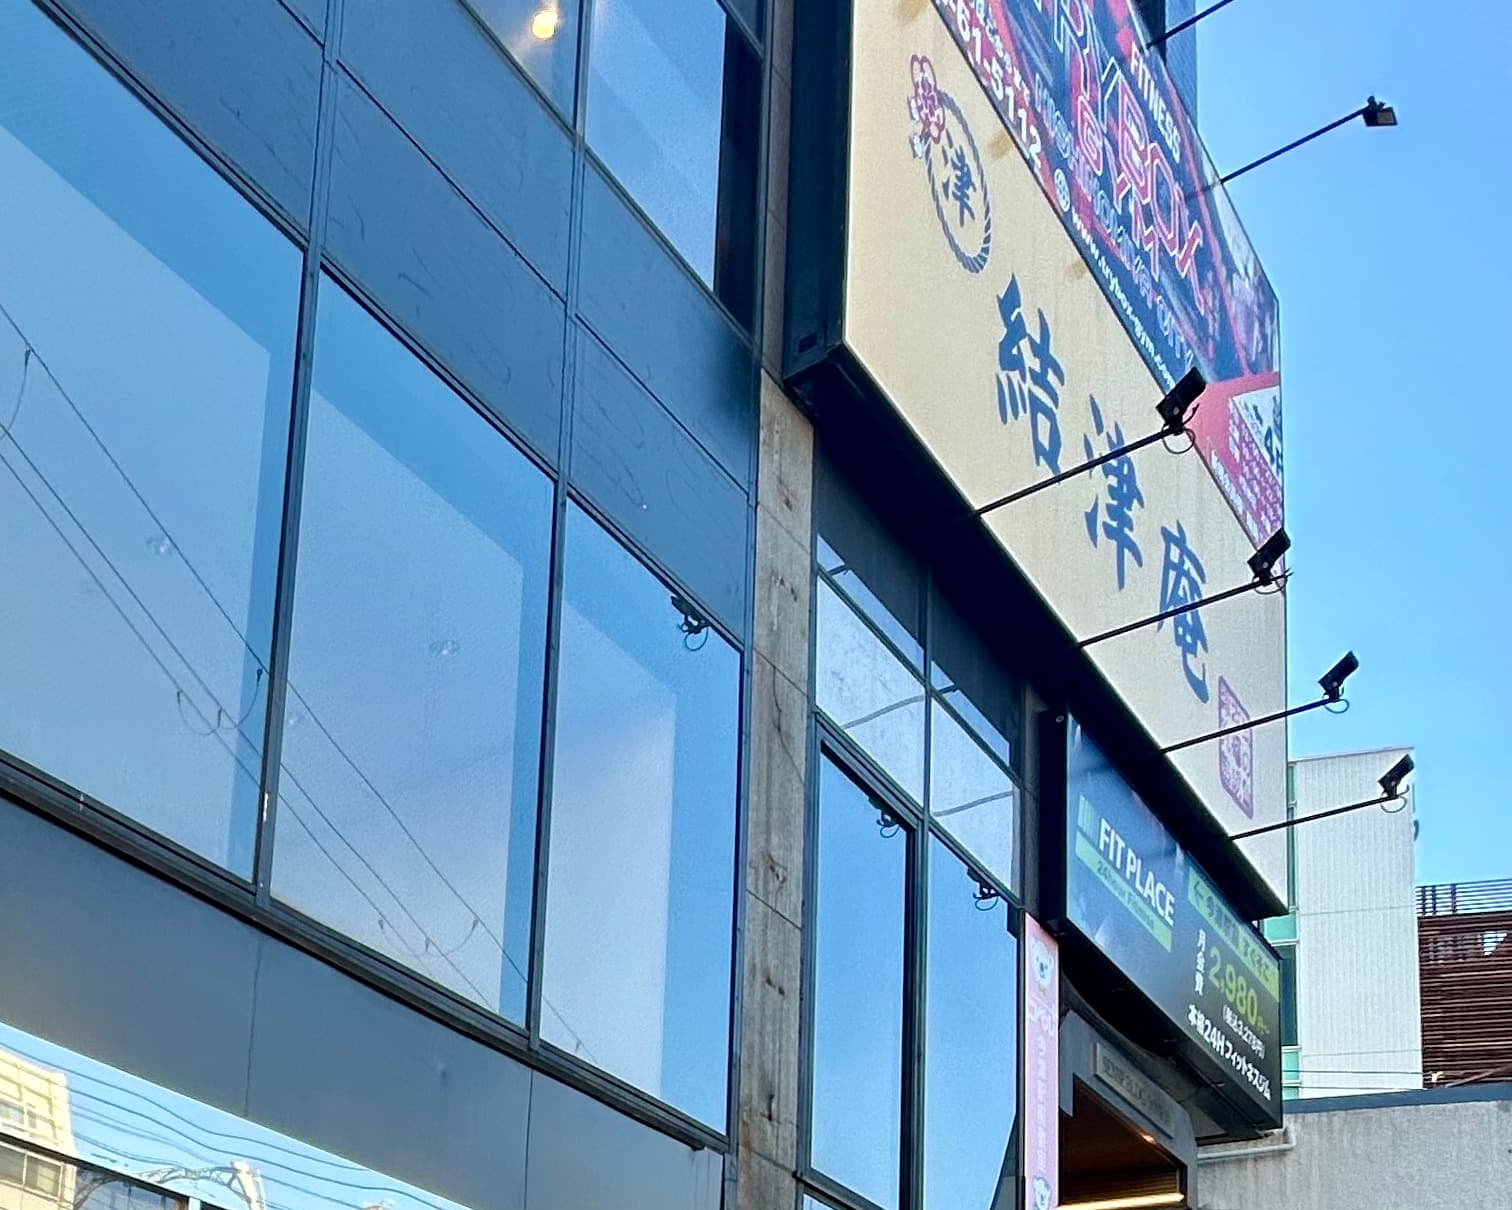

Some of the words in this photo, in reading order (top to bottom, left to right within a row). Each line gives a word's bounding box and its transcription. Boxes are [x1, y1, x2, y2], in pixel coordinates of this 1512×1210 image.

[935, 0, 1042, 170] -61-5112
[1031, 0, 1204, 315] RYBOX
[1130, 43, 1182, 163] FITNESS
[1076, 94, 1159, 281] GYM
